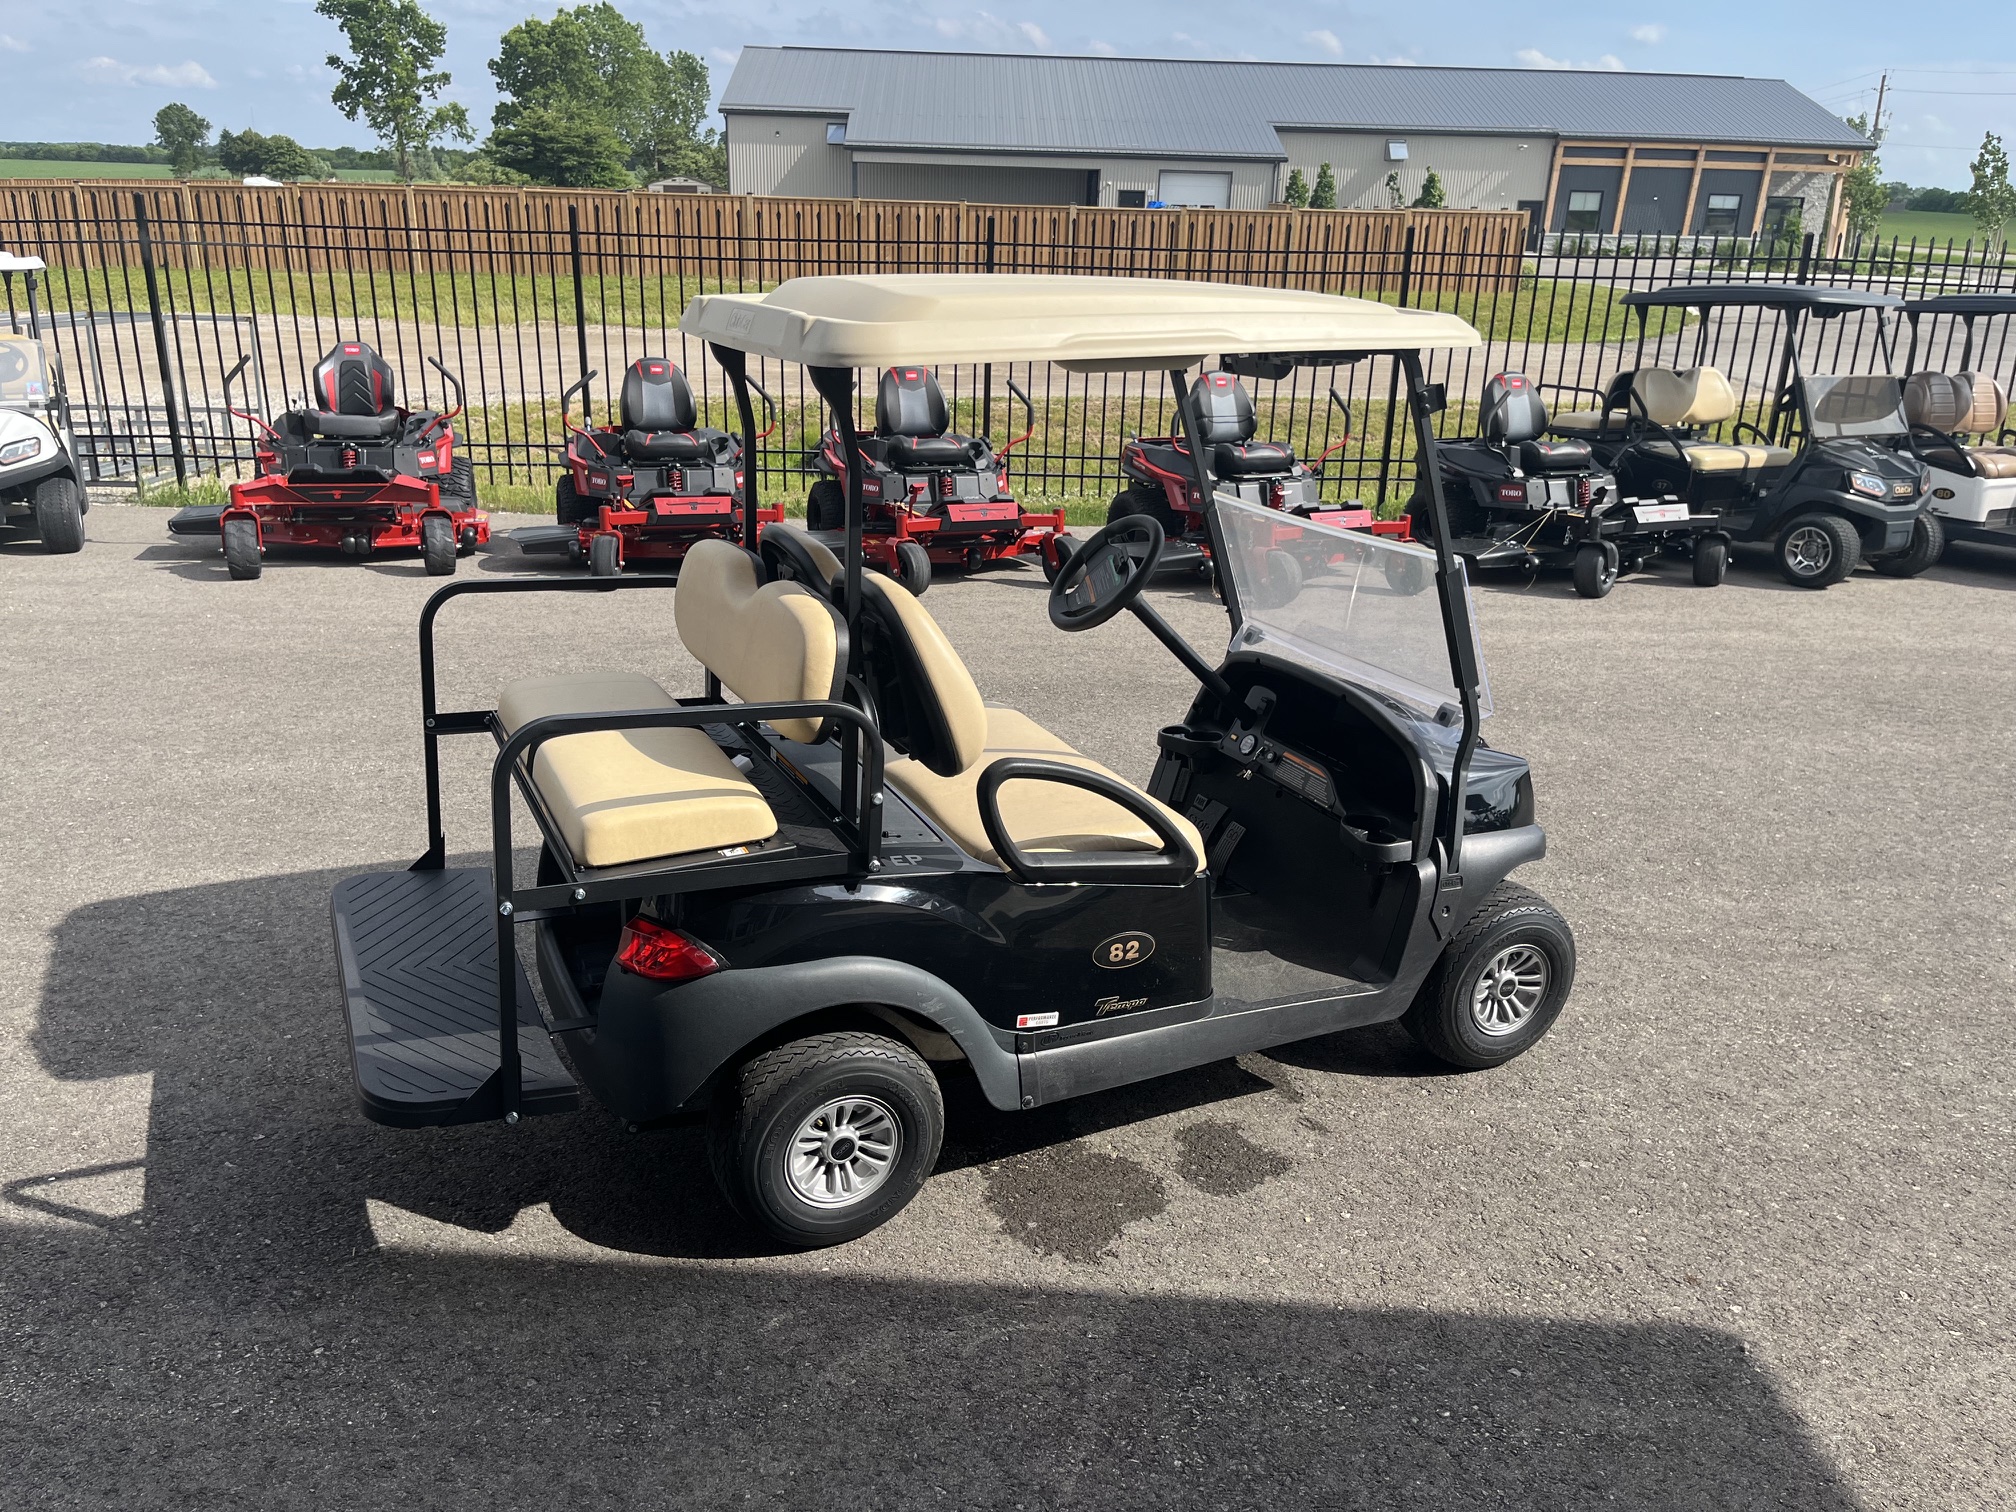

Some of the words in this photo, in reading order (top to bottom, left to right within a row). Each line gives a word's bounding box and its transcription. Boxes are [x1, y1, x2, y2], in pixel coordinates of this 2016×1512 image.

[418, 455, 435, 465] TORO
[591, 476, 607, 486] TORO
[862, 483, 879, 492] TORO
[1501, 489, 1522, 497] TORO
[1936, 489, 1951, 499] 80
[1109, 940, 1140, 962] 82
